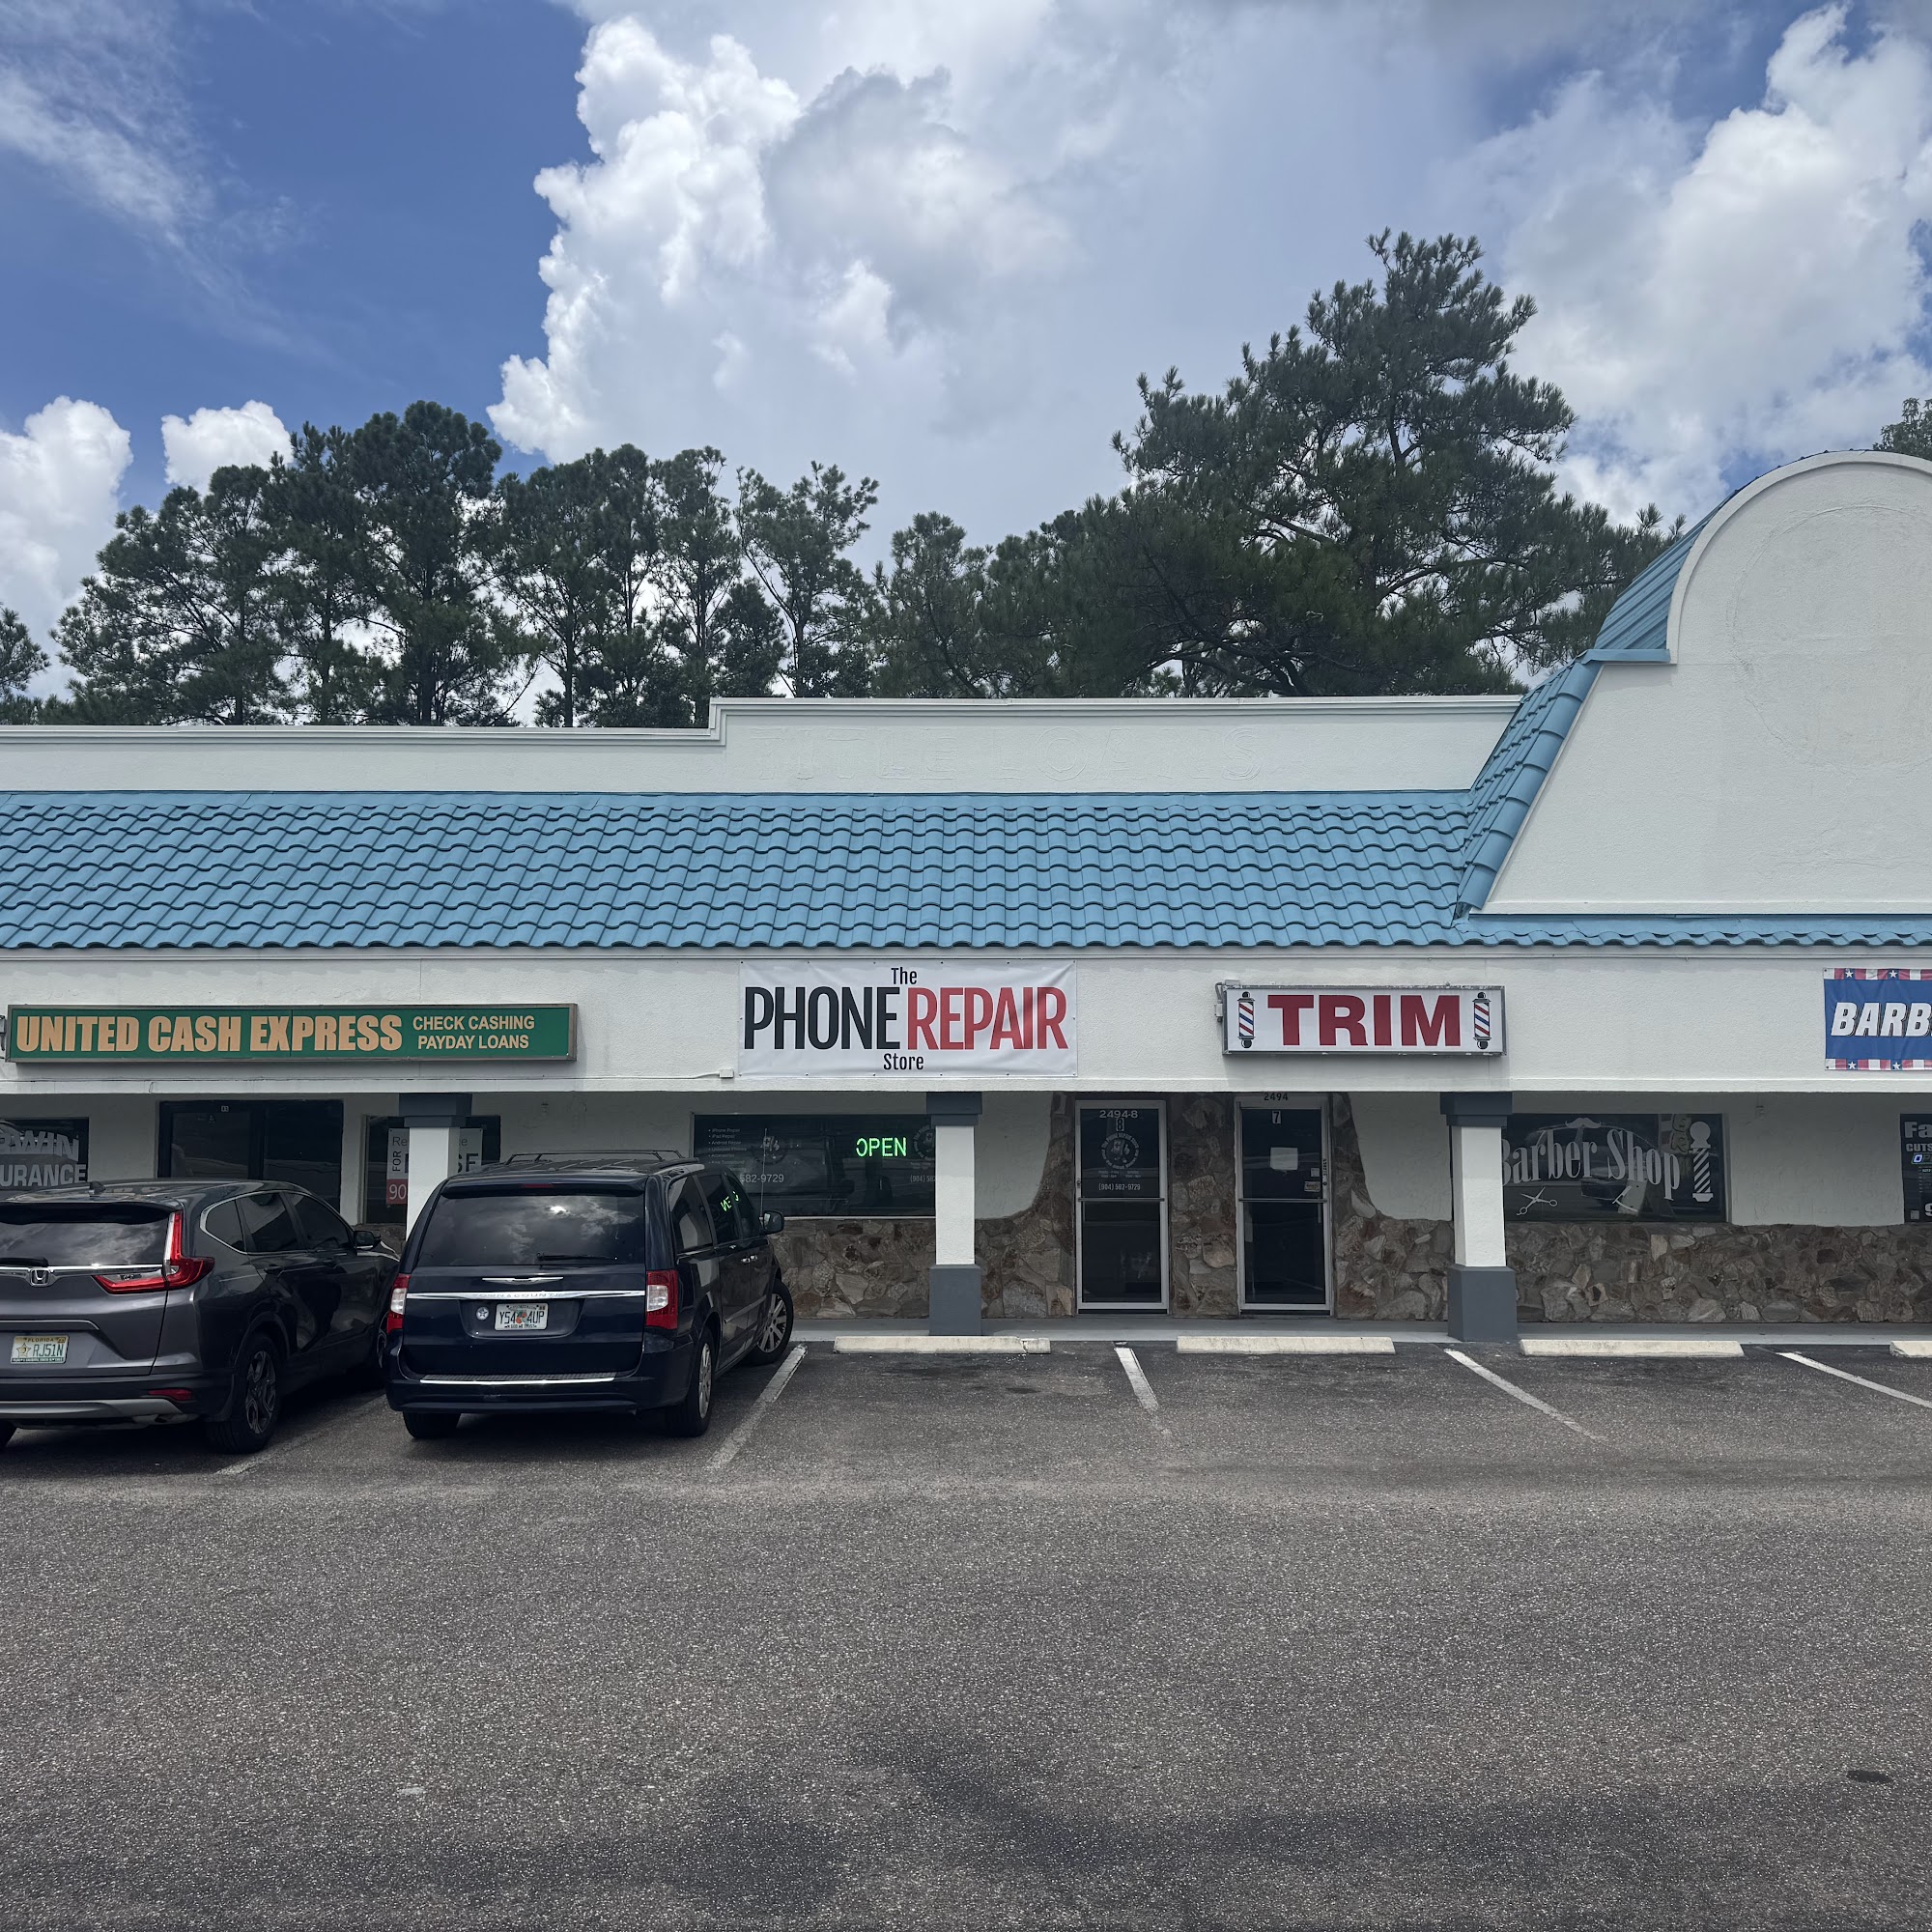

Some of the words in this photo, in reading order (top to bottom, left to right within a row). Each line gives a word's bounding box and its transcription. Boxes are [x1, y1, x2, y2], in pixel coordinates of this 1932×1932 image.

[891, 966, 918, 985] The
[412, 1016, 466, 1031] CHECK
[468, 1015, 535, 1031] CASHING
[743, 986, 900, 1051] PHONE
[907, 986, 1068, 1051] REPAIR
[1267, 994, 1462, 1047] TRIM
[1831, 1002, 1932, 1037] BARB
[16, 1015, 140, 1052] UNITED
[148, 1015, 242, 1052] CASH
[249, 1014, 403, 1052] EXPRESS
[417, 1035, 477, 1050] PAYDAY
[478, 1035, 529, 1050] LOANS
[883, 1053, 924, 1071] Store
[1264, 1093, 1289, 1101] 2494
[1098, 1110, 1139, 1119] 2494-8
[1273, 1111, 1280, 1123] 7
[1117, 1119, 1123, 1131] 8
[856, 1137, 907, 1157] OPEN
[392, 1151, 402, 1172] FOR
[1606, 1128, 1681, 1201] Shop
[739, 1174, 784, 1183] 582-9729
[1098, 1182, 1115, 1191] (904)
[388, 1183, 407, 1200] 90
[526, 1310, 545, 1323] 4UP
[32, 1344, 64, 1357] RJ51N
